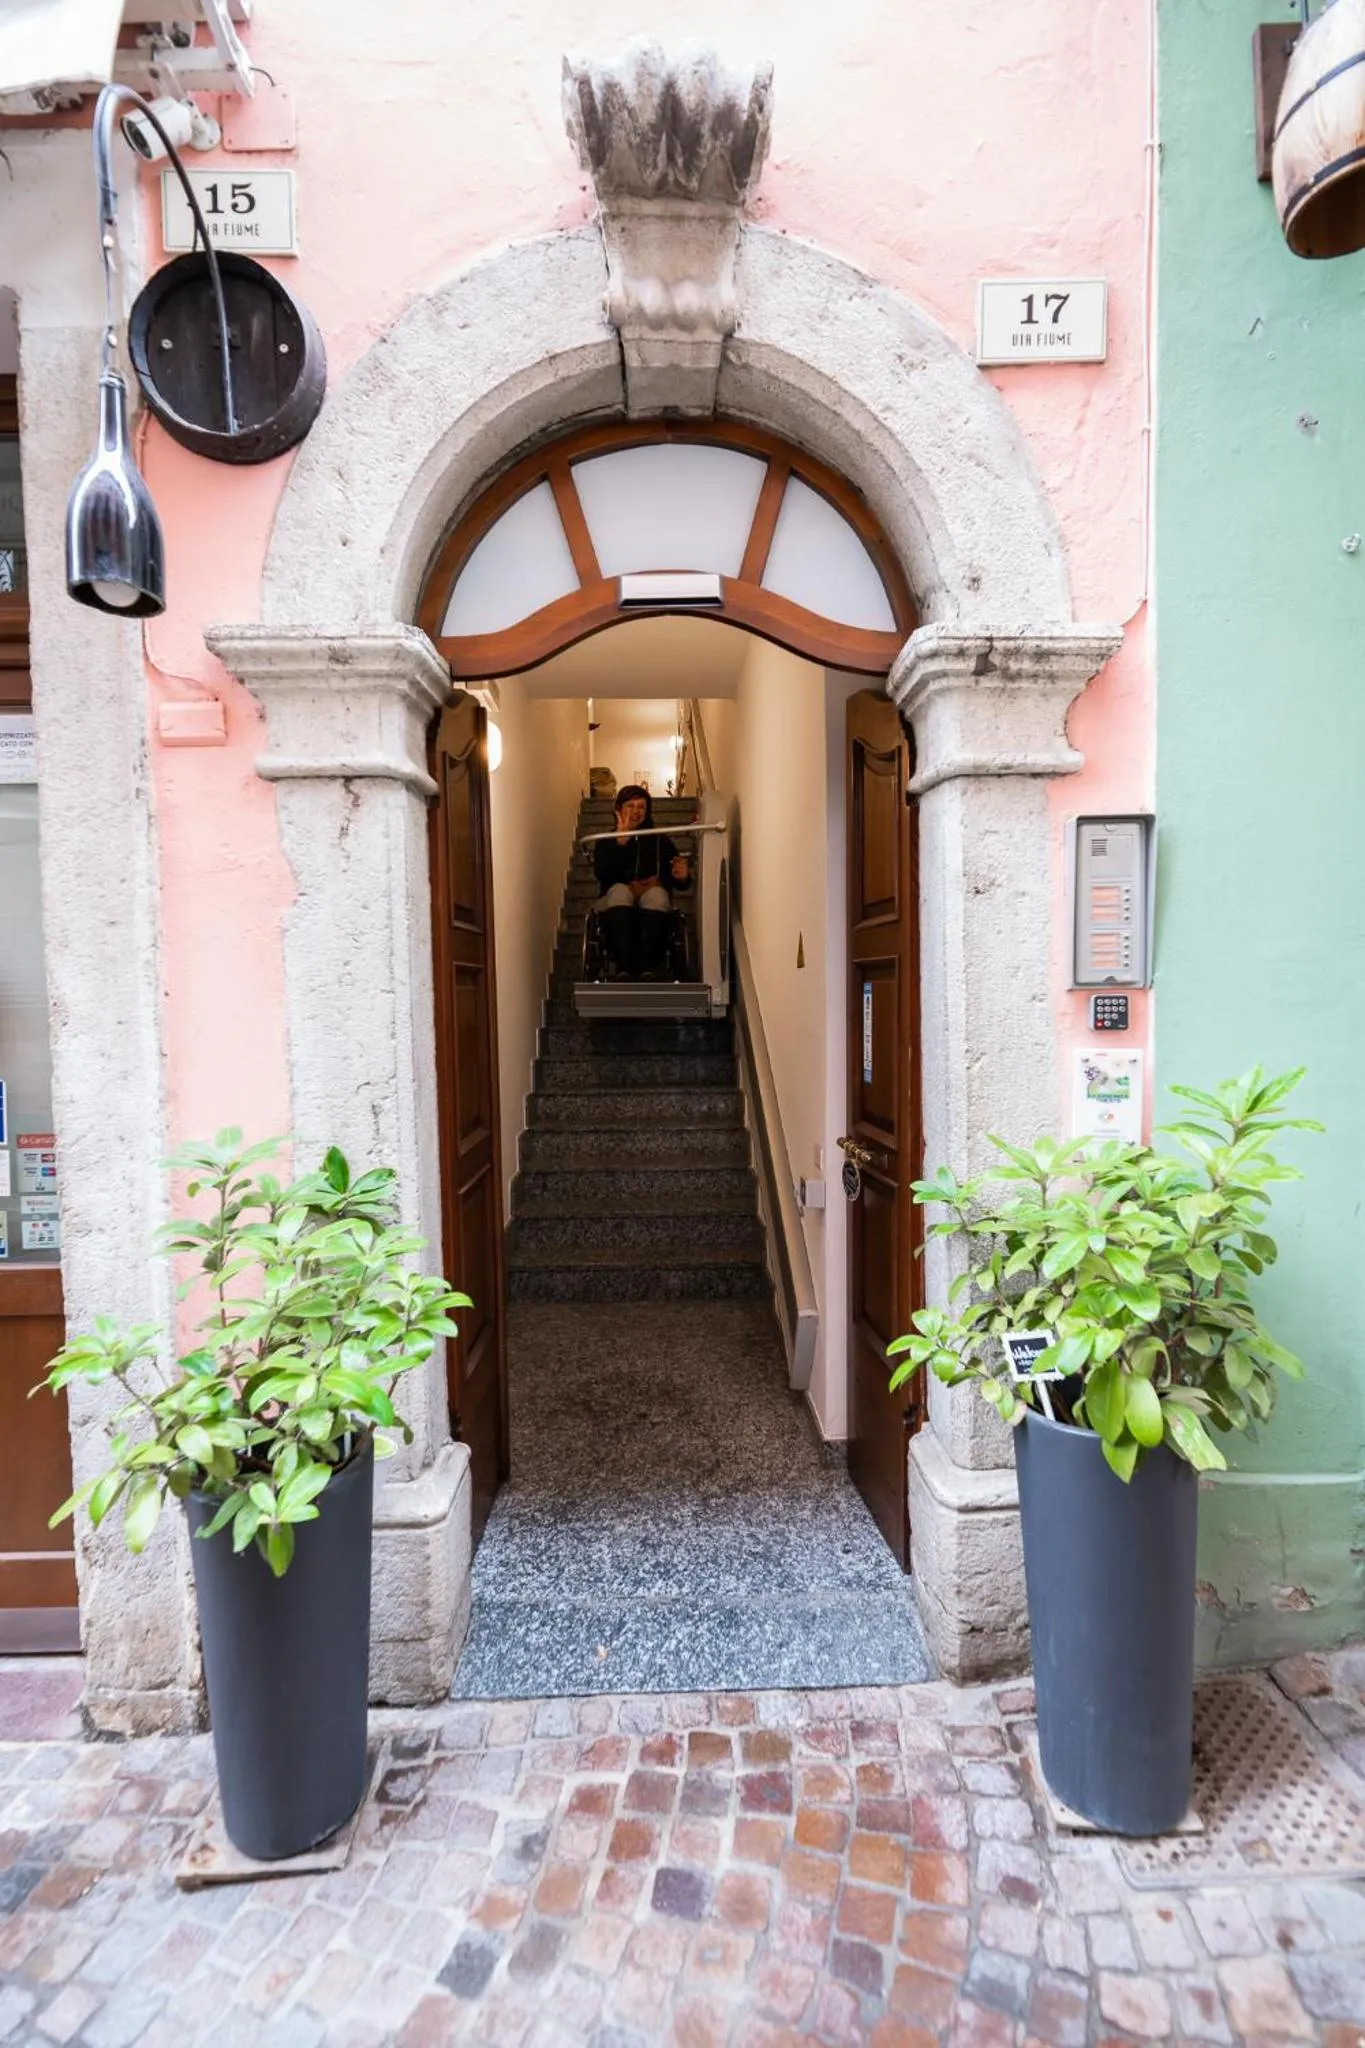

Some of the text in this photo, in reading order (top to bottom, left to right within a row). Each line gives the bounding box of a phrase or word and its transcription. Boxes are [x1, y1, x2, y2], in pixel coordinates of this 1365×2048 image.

[204, 182, 256, 214] 15
[200, 223, 260, 236] IA FIUME
[1020, 293, 1071, 325] 17
[1037, 332, 1072, 346] FIUME
